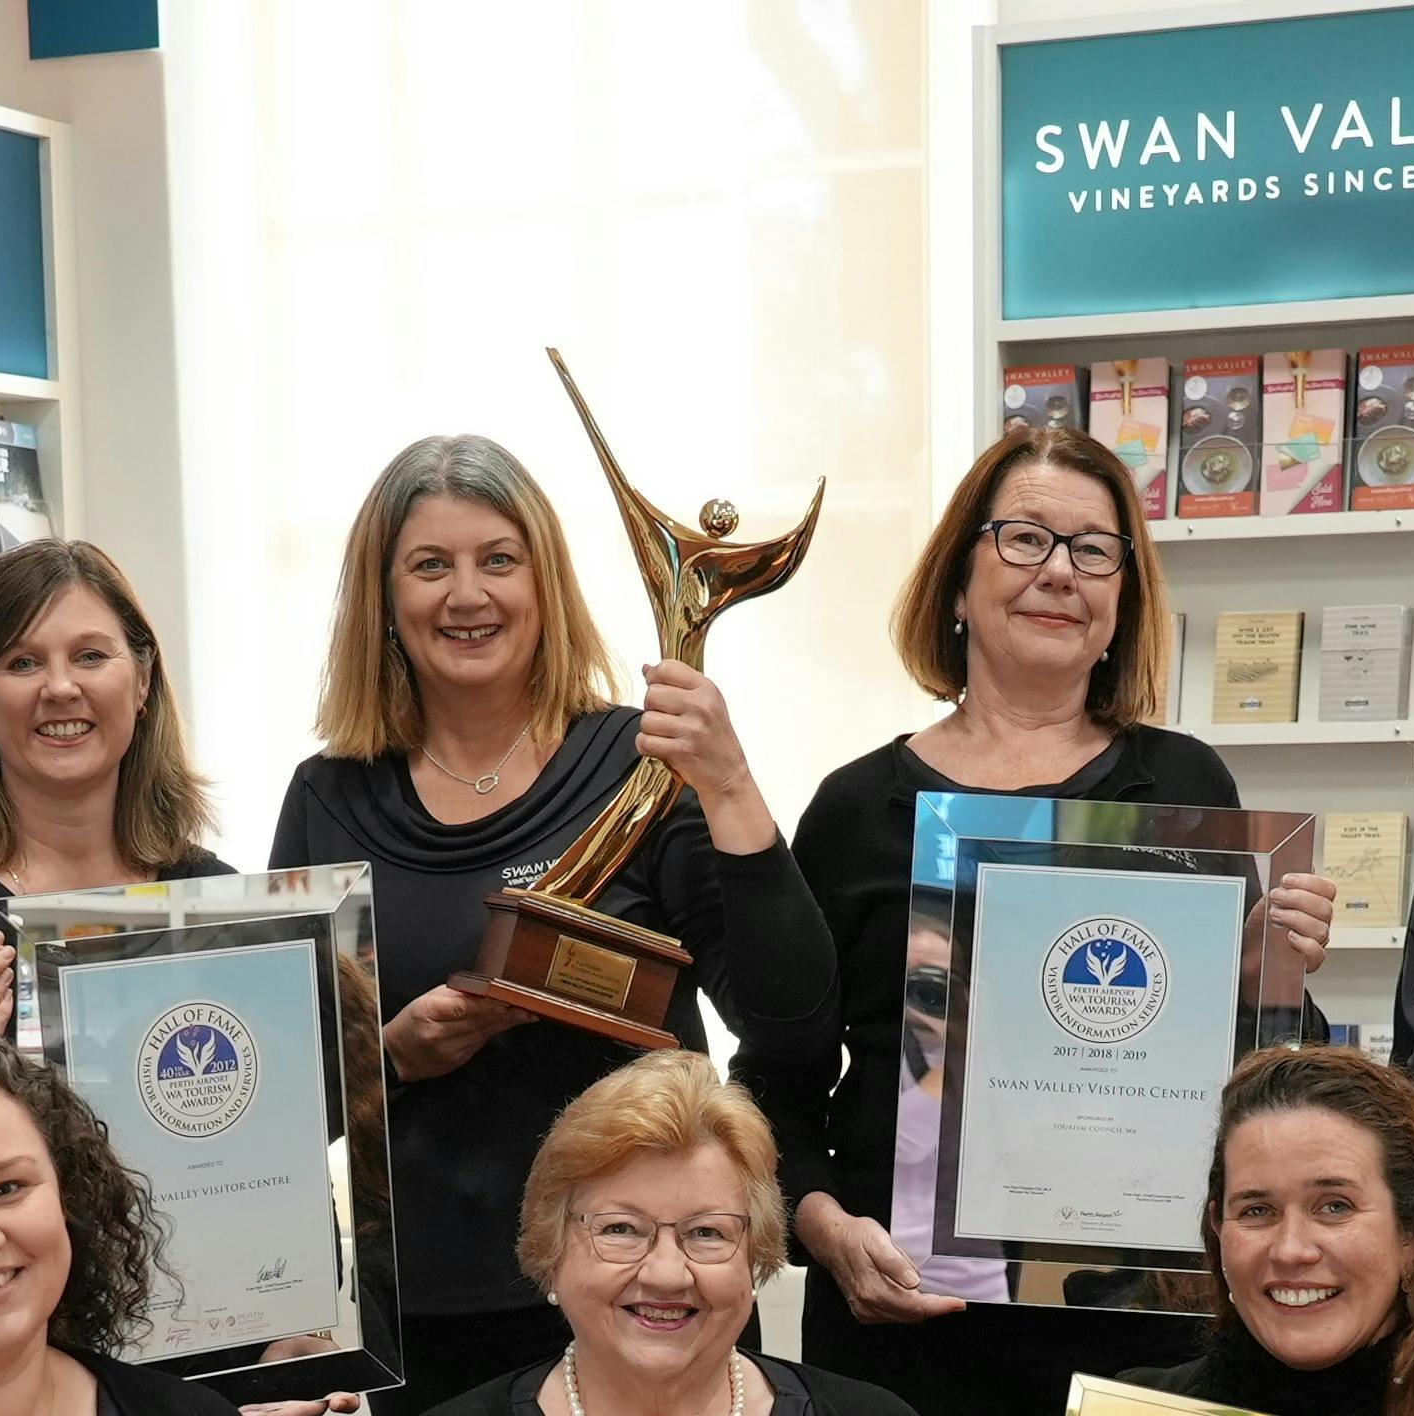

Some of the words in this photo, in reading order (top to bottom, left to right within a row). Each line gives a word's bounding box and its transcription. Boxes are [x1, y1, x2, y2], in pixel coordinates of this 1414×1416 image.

[1035, 111, 1236, 174] SWAN
[1068, 176, 1280, 214] VINEYARDS
[1216, 360, 1254, 370] VALLEY
[1360, 352, 1390, 363] SWAN
[1035, 368, 1072, 379] VALLEY
[501, 861, 544, 879] SWAN
[1058, 926, 1095, 956] HALL
[1097, 923, 1119, 936] OF
[1122, 927, 1156, 962] FAME
[1073, 986, 1099, 994] PERTH
[1101, 987, 1136, 997] AIRPORT
[1048, 966, 1064, 1013] VISITOR
[1059, 1010, 1139, 1039] INFORMATION
[1138, 972, 1163, 1022] SERVICES
[1068, 994, 1086, 1004] WA
[1089, 995, 1137, 1007] TOURISM
[1081, 1006, 1127, 1016] AWARDS
[149, 1016, 182, 1050] HALL
[183, 1009, 204, 1022] OF
[208, 1010, 244, 1042] FAME
[1053, 1046, 1078, 1057] 2017
[1087, 1048, 1112, 1059] 2018
[1122, 1050, 1147, 1061] 2019
[159, 1067, 174, 1079] 40
[210, 1060, 236, 1073] 2012
[143, 1056, 157, 1103] VISITOR
[153, 1102, 223, 1132] INFORMATION
[224, 1098, 243, 1121] AND
[240, 1046, 253, 1098] SERVICES
[169, 1080, 194, 1088] PERTH
[196, 1075, 228, 1085] AIRPORT
[989, 1077, 1029, 1091] SWAN
[1034, 1080, 1084, 1095] VALLEY
[1087, 1082, 1146, 1098] VISITOR
[1149, 1086, 1208, 1101] CENTRE
[166, 1090, 183, 1100] WA
[185, 1084, 232, 1098] TOURISM
[180, 1095, 224, 1110] AWARDS
[160, 1188, 199, 1203] VALLEY
[202, 1182, 246, 1197] VISITOR
[248, 1175, 291, 1189] CENTRE
